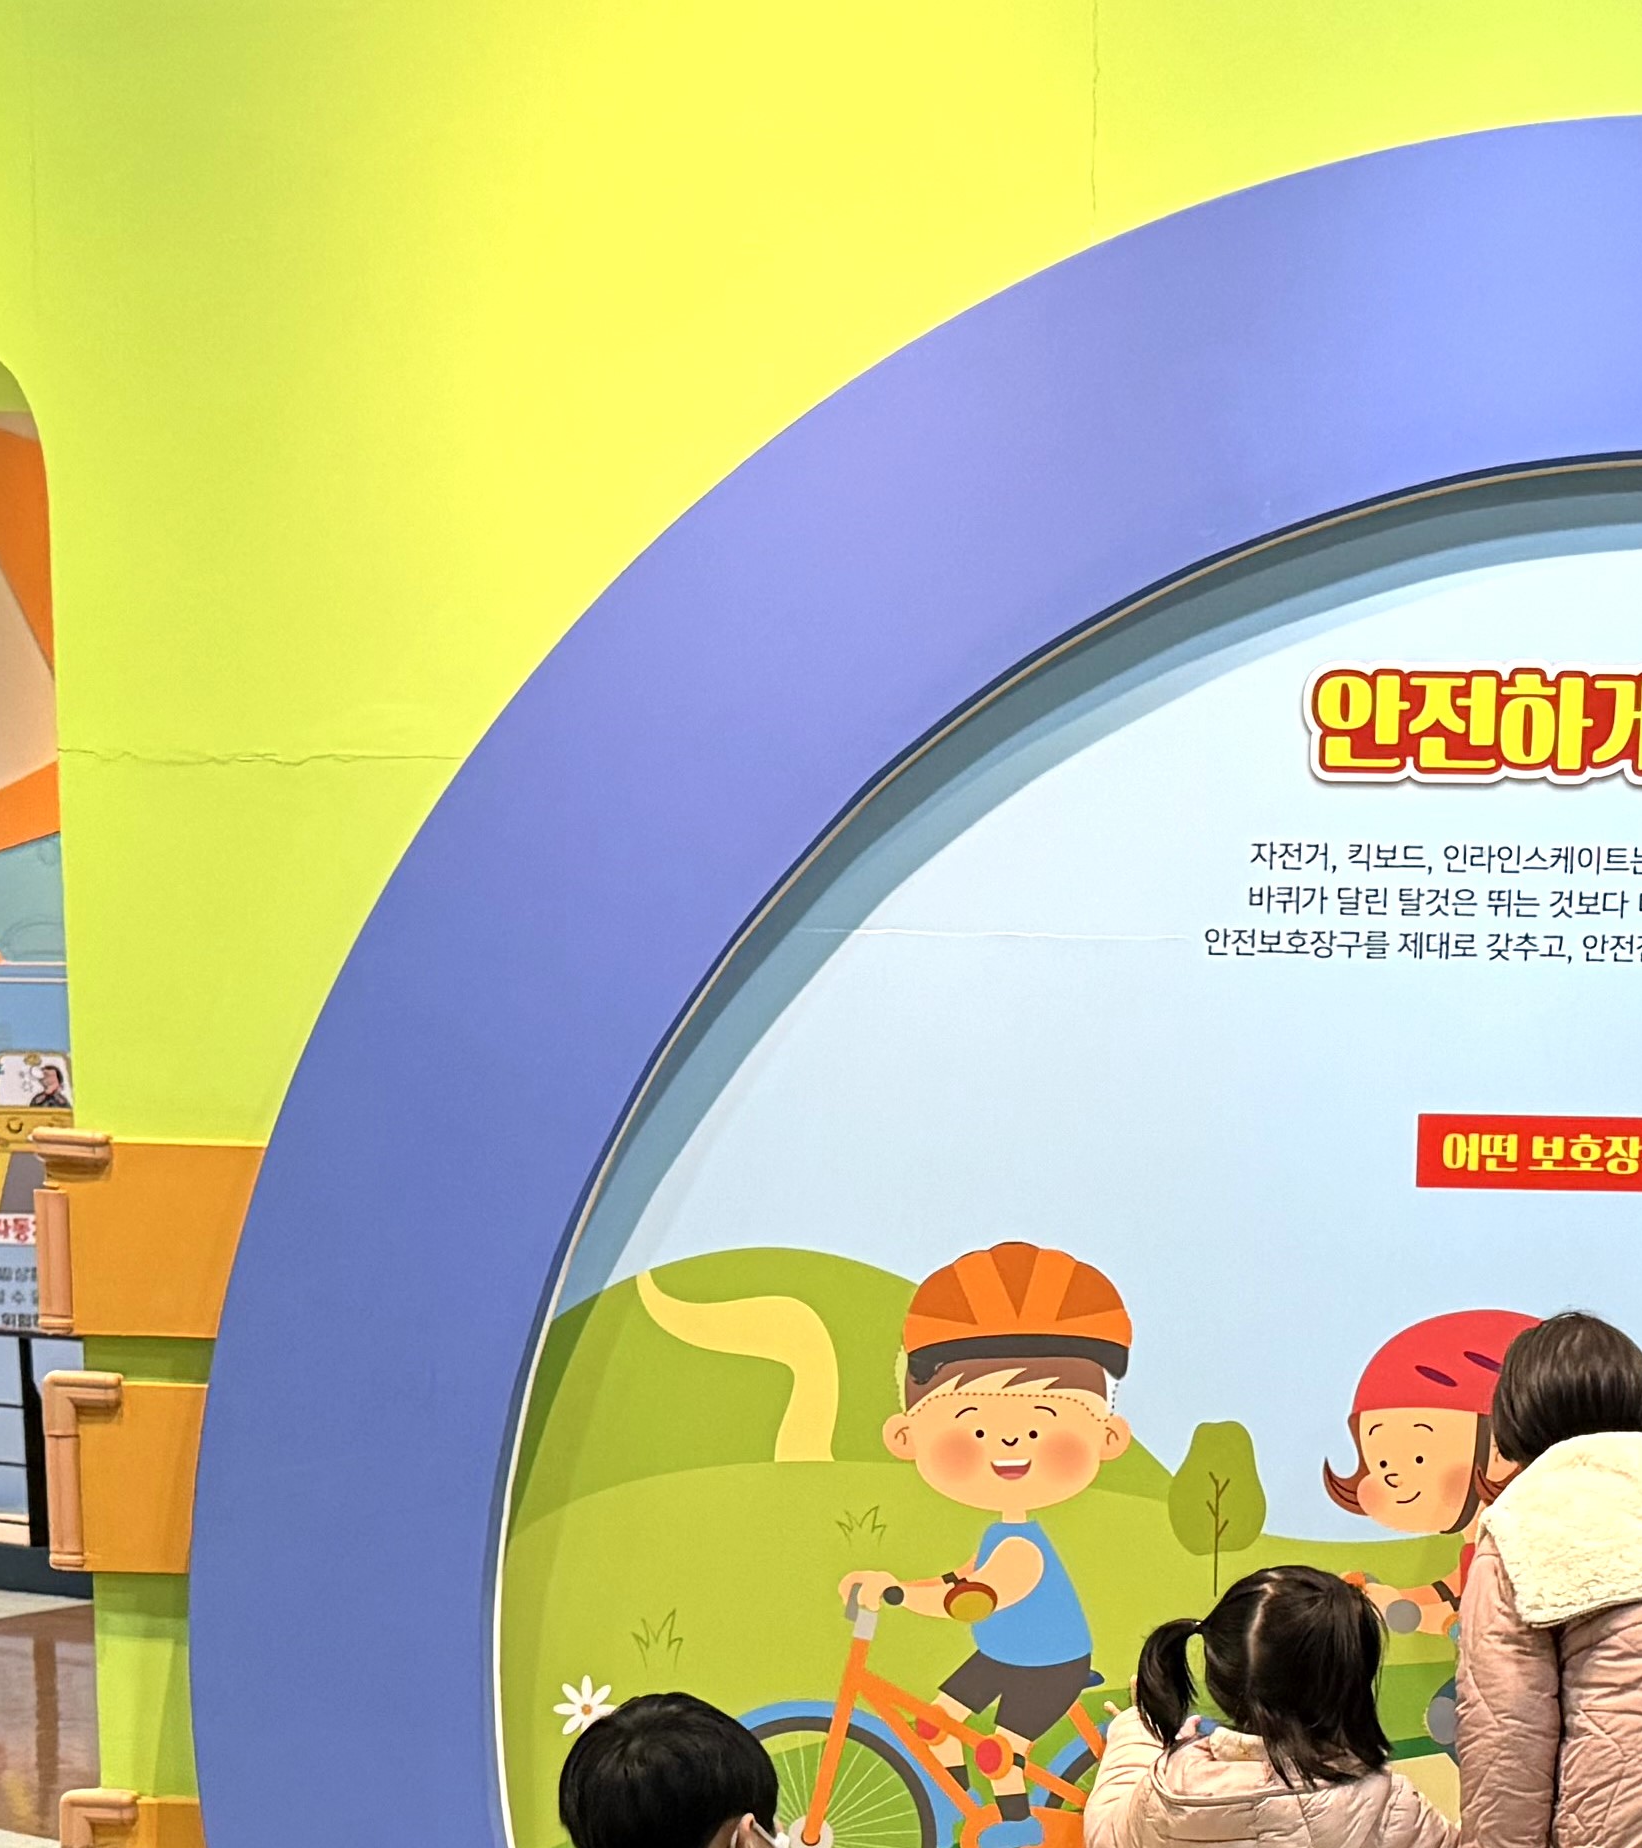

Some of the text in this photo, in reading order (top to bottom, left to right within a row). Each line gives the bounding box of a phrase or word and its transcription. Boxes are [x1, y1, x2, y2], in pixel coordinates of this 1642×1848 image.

[1250, 841, 1337, 874] 자전거,
[1348, 843, 1433, 875] 킥보드,
[1249, 885, 1329, 915] 바퀴가
[1337, 886, 1388, 916] 달린
[1398, 887, 1478, 917] 탈것은
[1487, 889, 1540, 918] 뛰는
[1549, 889, 1630, 919] 것보다
[1204, 928, 1390, 960] 안전보호장구를
[1397, 931, 1478, 960] 제대로
[1486, 932, 1572, 964] 갖추고,
[1442, 1133, 1518, 1172] 어떤
